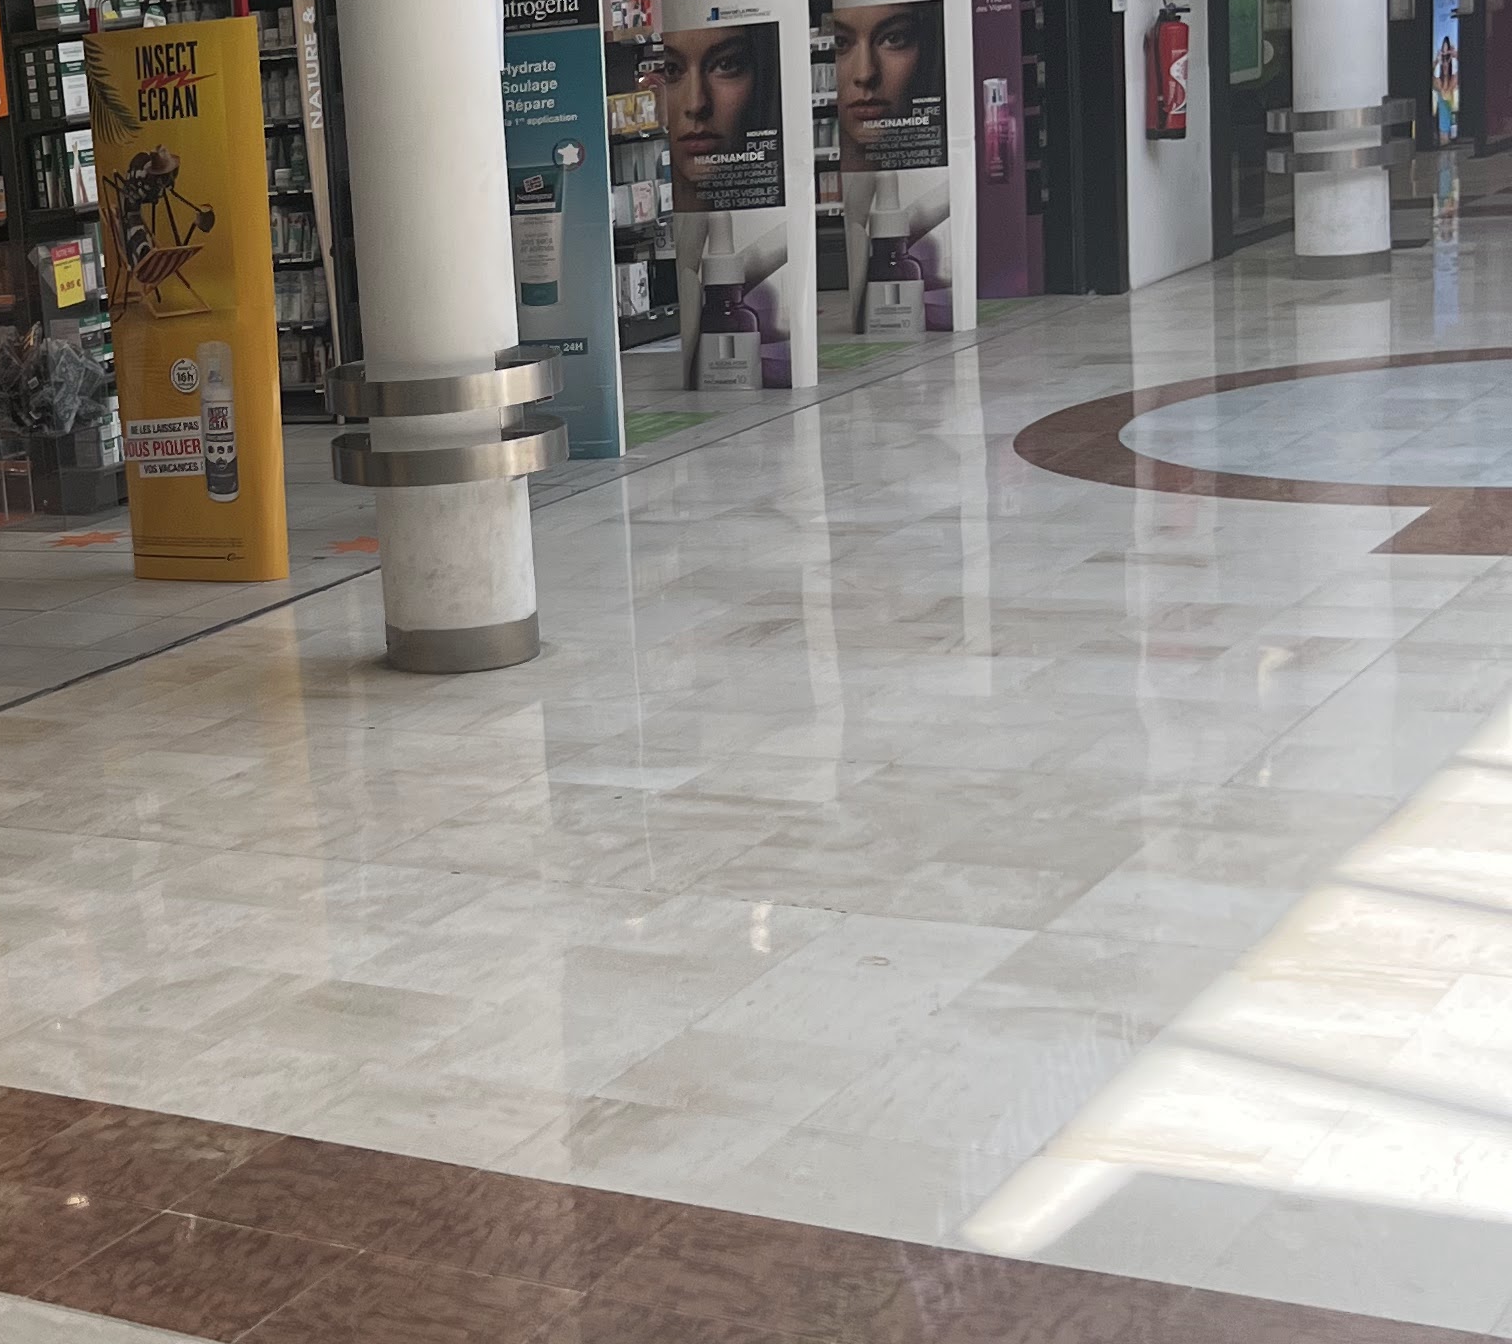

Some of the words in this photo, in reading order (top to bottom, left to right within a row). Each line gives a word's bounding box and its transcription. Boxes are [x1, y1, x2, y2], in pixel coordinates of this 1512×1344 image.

[303, 6, 315, 23] &
[135, 41, 198, 80] INSECT
[501, 60, 556, 77] Hydrate
[304, 32, 322, 129] NATURE
[502, 80, 558, 94] Soulage
[137, 82, 198, 121] ECRAN
[505, 98, 555, 113] Répare
[912, 106, 941, 116] PURE
[527, 114, 578, 126] application
[863, 116, 930, 128] NIACINAMIDE
[746, 139, 777, 151] PURE
[694, 151, 765, 165] NIACINAMIDE
[562, 342, 583, 352] 24H
[140, 424, 151, 434] LES
[152, 422, 181, 434] LAISSEZ
[183, 421, 199, 431] PAS
[152, 438, 201, 456] PIQUER
[143, 464, 157, 474] VOS
[158, 462, 199, 473] VACANCES
